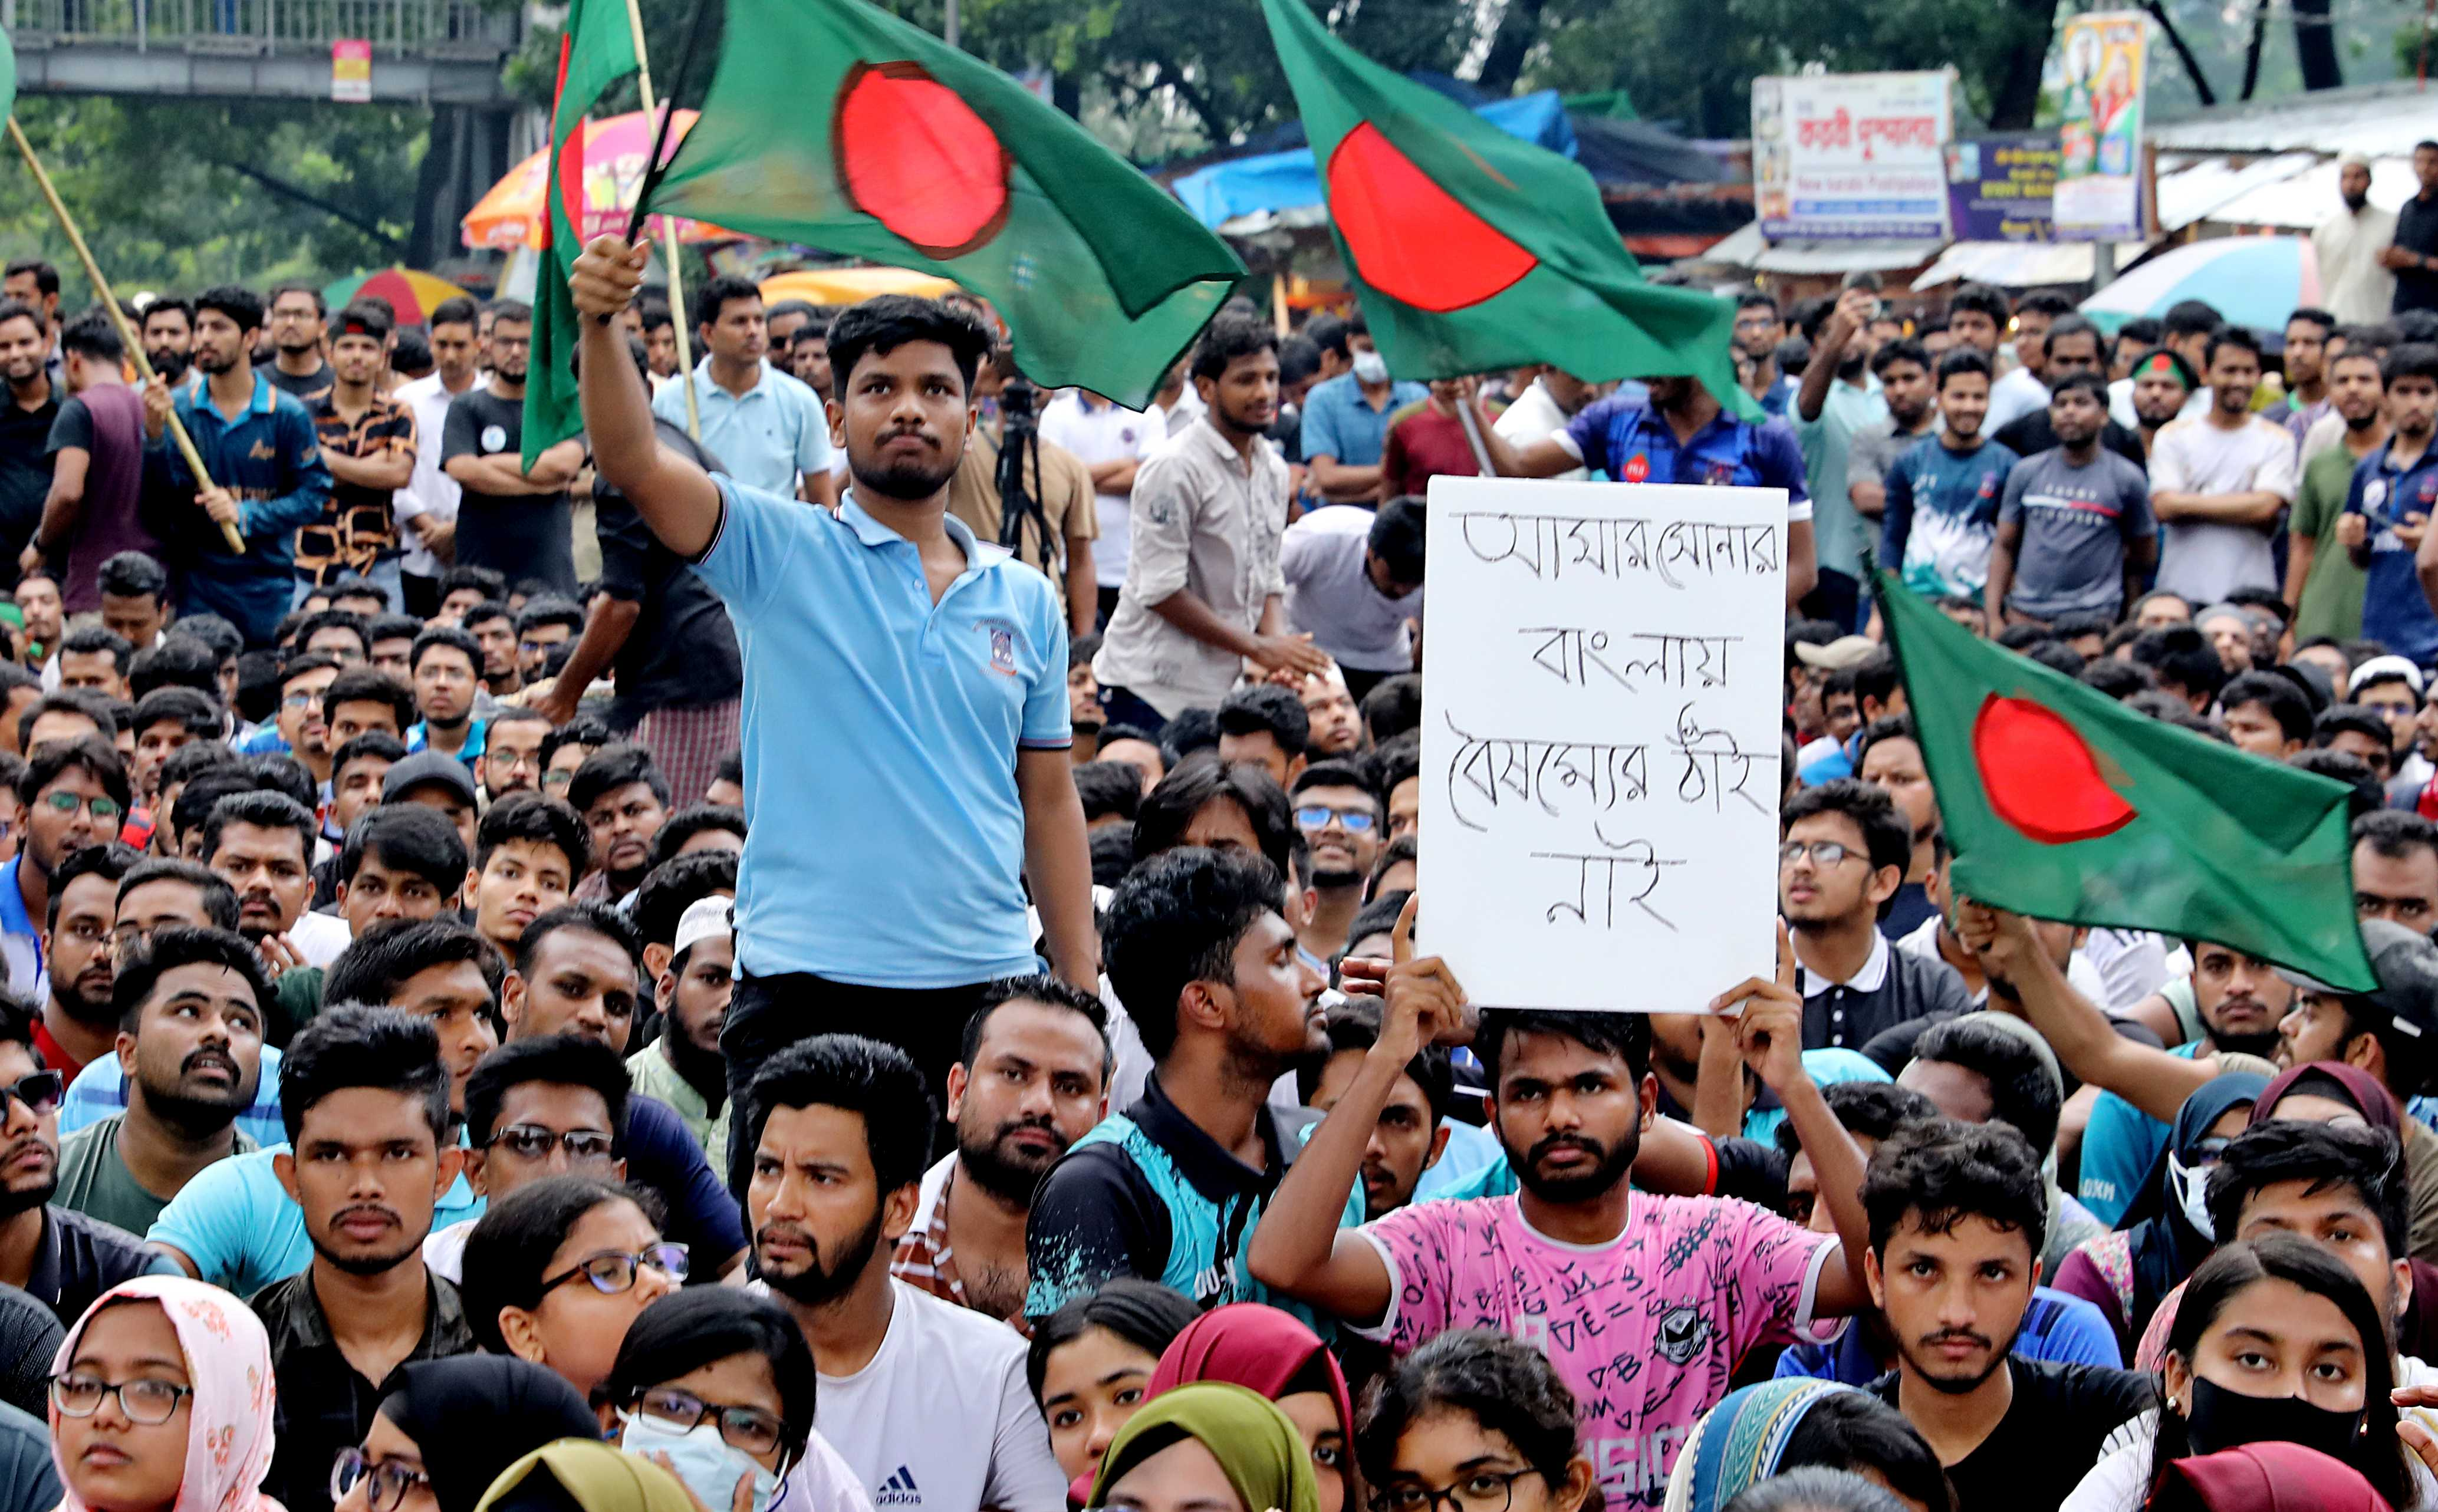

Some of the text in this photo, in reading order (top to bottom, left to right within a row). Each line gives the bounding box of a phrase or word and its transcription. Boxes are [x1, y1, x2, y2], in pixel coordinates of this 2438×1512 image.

[1448, 512, 1778, 589] আমার সোনার
[1518, 627, 1743, 693] বাংলায়
[1445, 709, 1650, 832] বৈষম্যের
[1530, 821, 1687, 932] নাই
[876, 1492, 922, 1506] adidas
